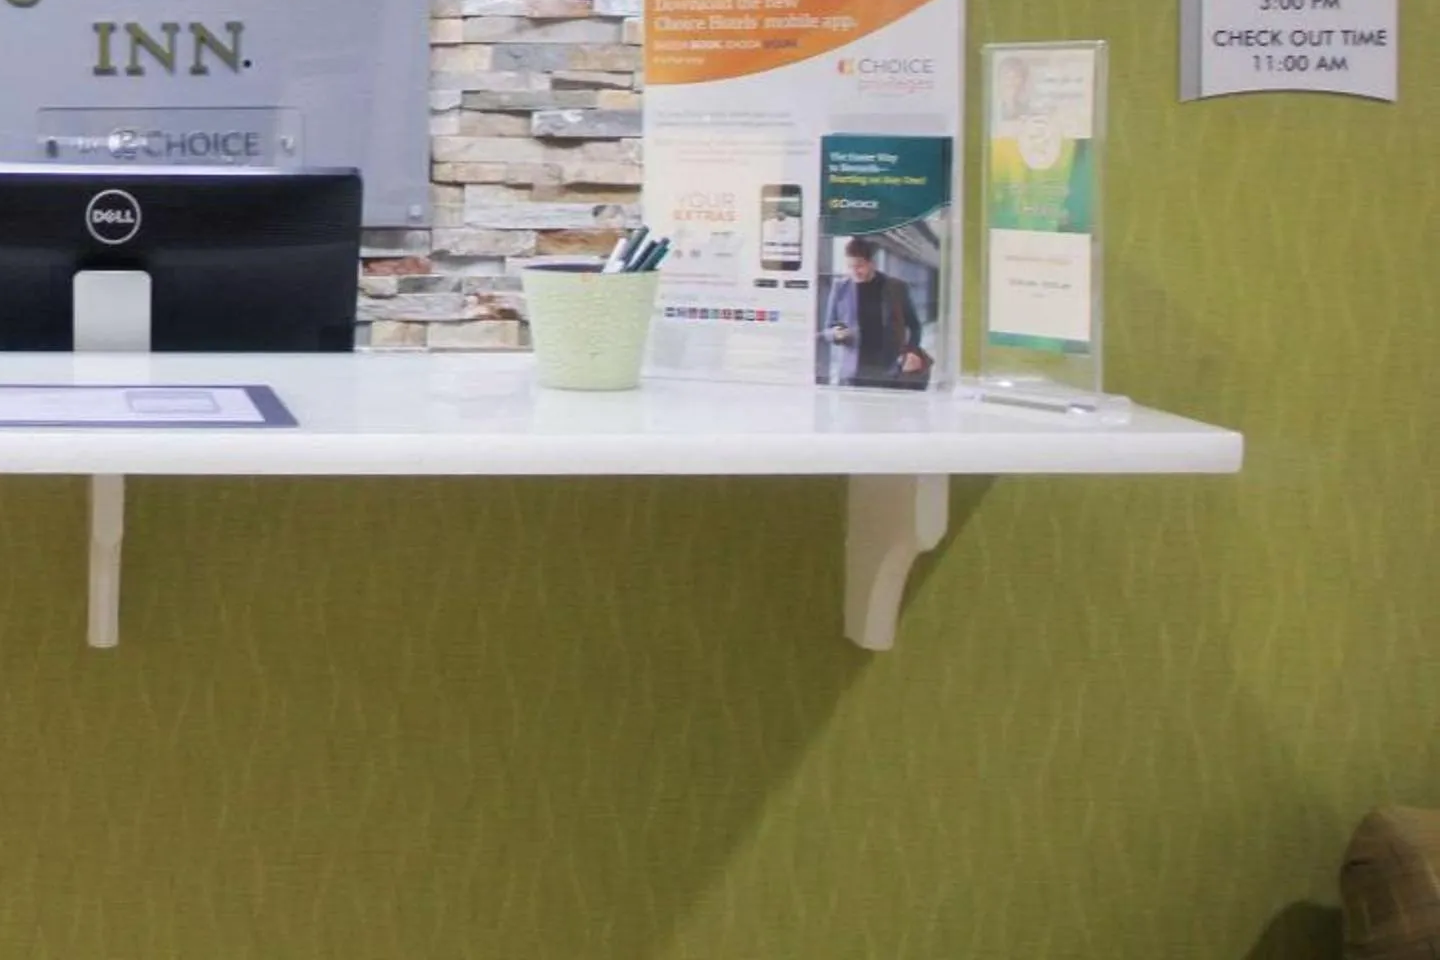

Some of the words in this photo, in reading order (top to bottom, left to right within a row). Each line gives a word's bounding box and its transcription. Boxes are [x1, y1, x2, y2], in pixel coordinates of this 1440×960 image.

[1212, 29, 1284, 47] CHECK
[1290, 29, 1335, 47] OUT
[1340, 29, 1387, 46] TIME
[858, 58, 936, 74] CHOICE
[1252, 55, 1309, 72] 11:00
[1315, 55, 1349, 72] AM
[142, 130, 260, 157] CHOICE
[92, 209, 135, 224] DELL
